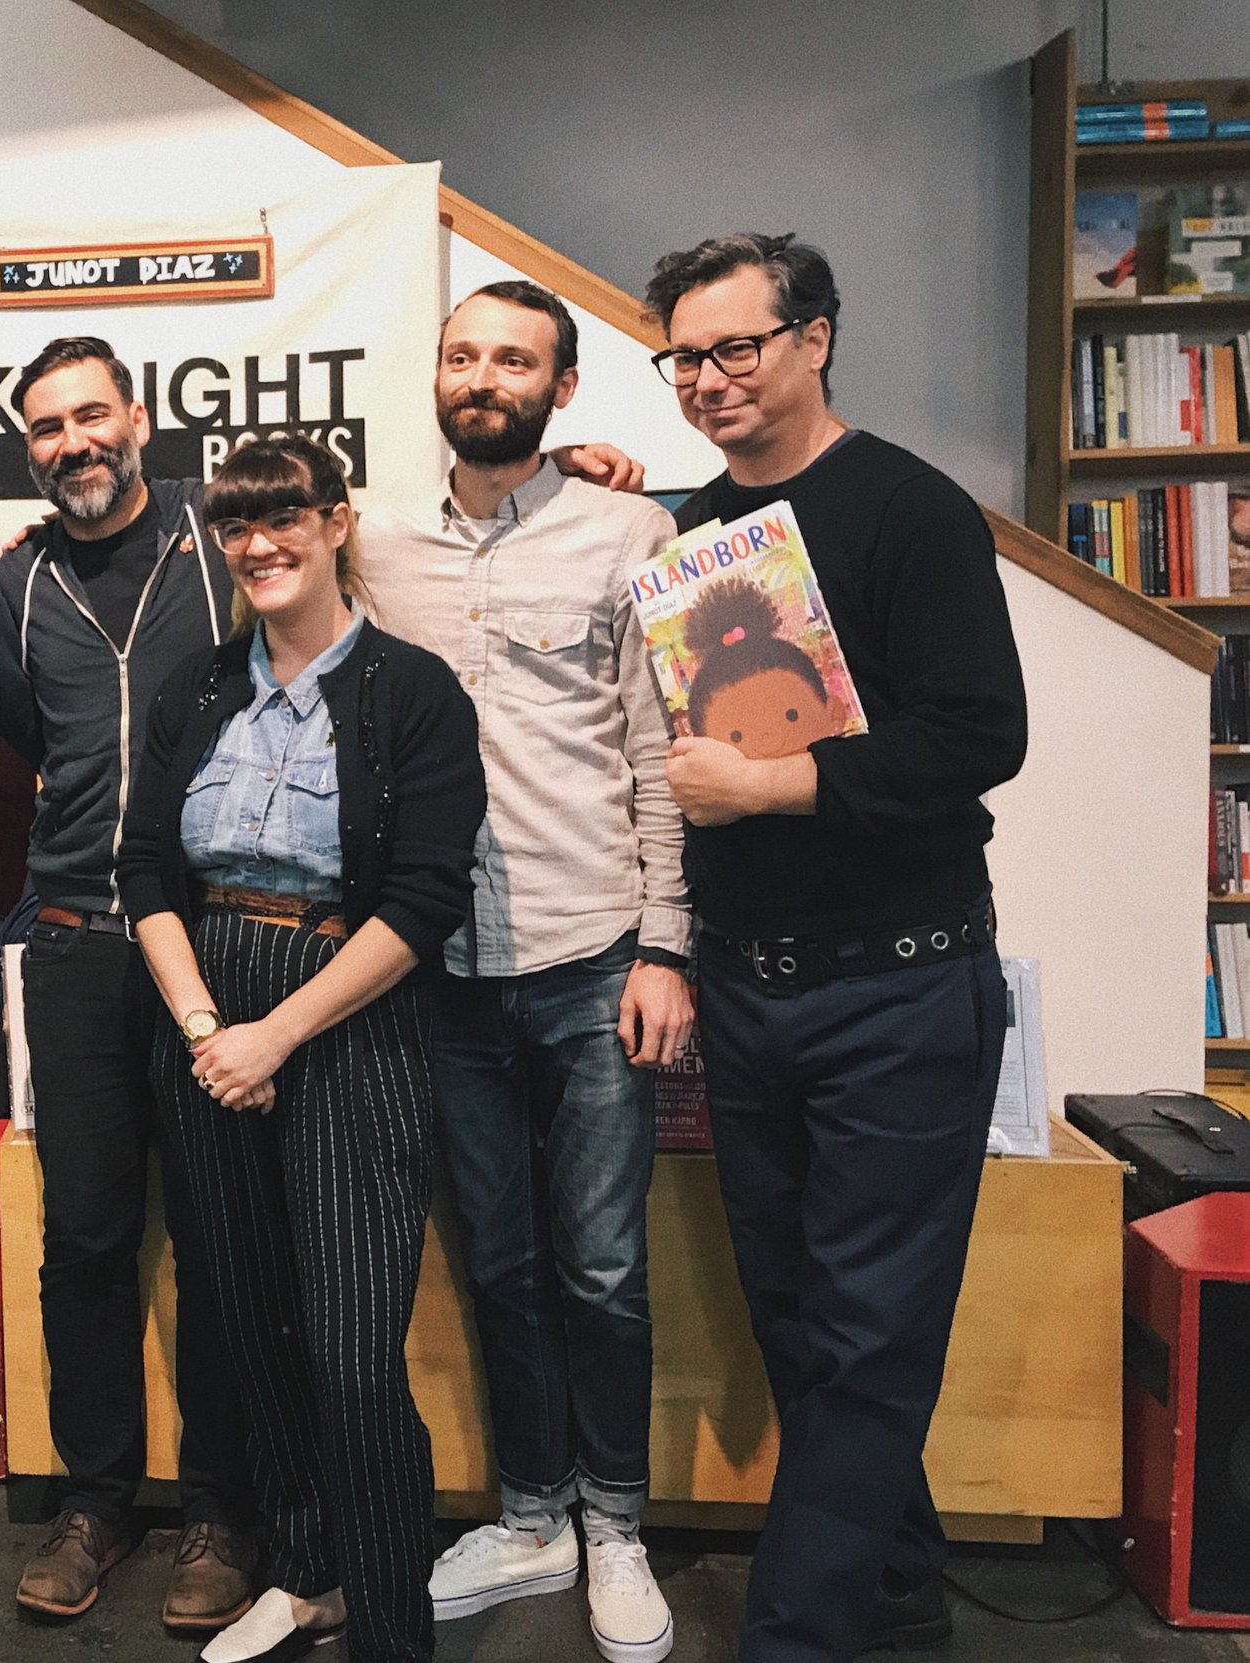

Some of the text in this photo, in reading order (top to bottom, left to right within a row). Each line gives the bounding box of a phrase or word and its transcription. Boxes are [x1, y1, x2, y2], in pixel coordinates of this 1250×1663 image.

[25, 254, 215, 288] JUNOT DIAZ
[632, 516, 787, 603] ISLANDBORN
